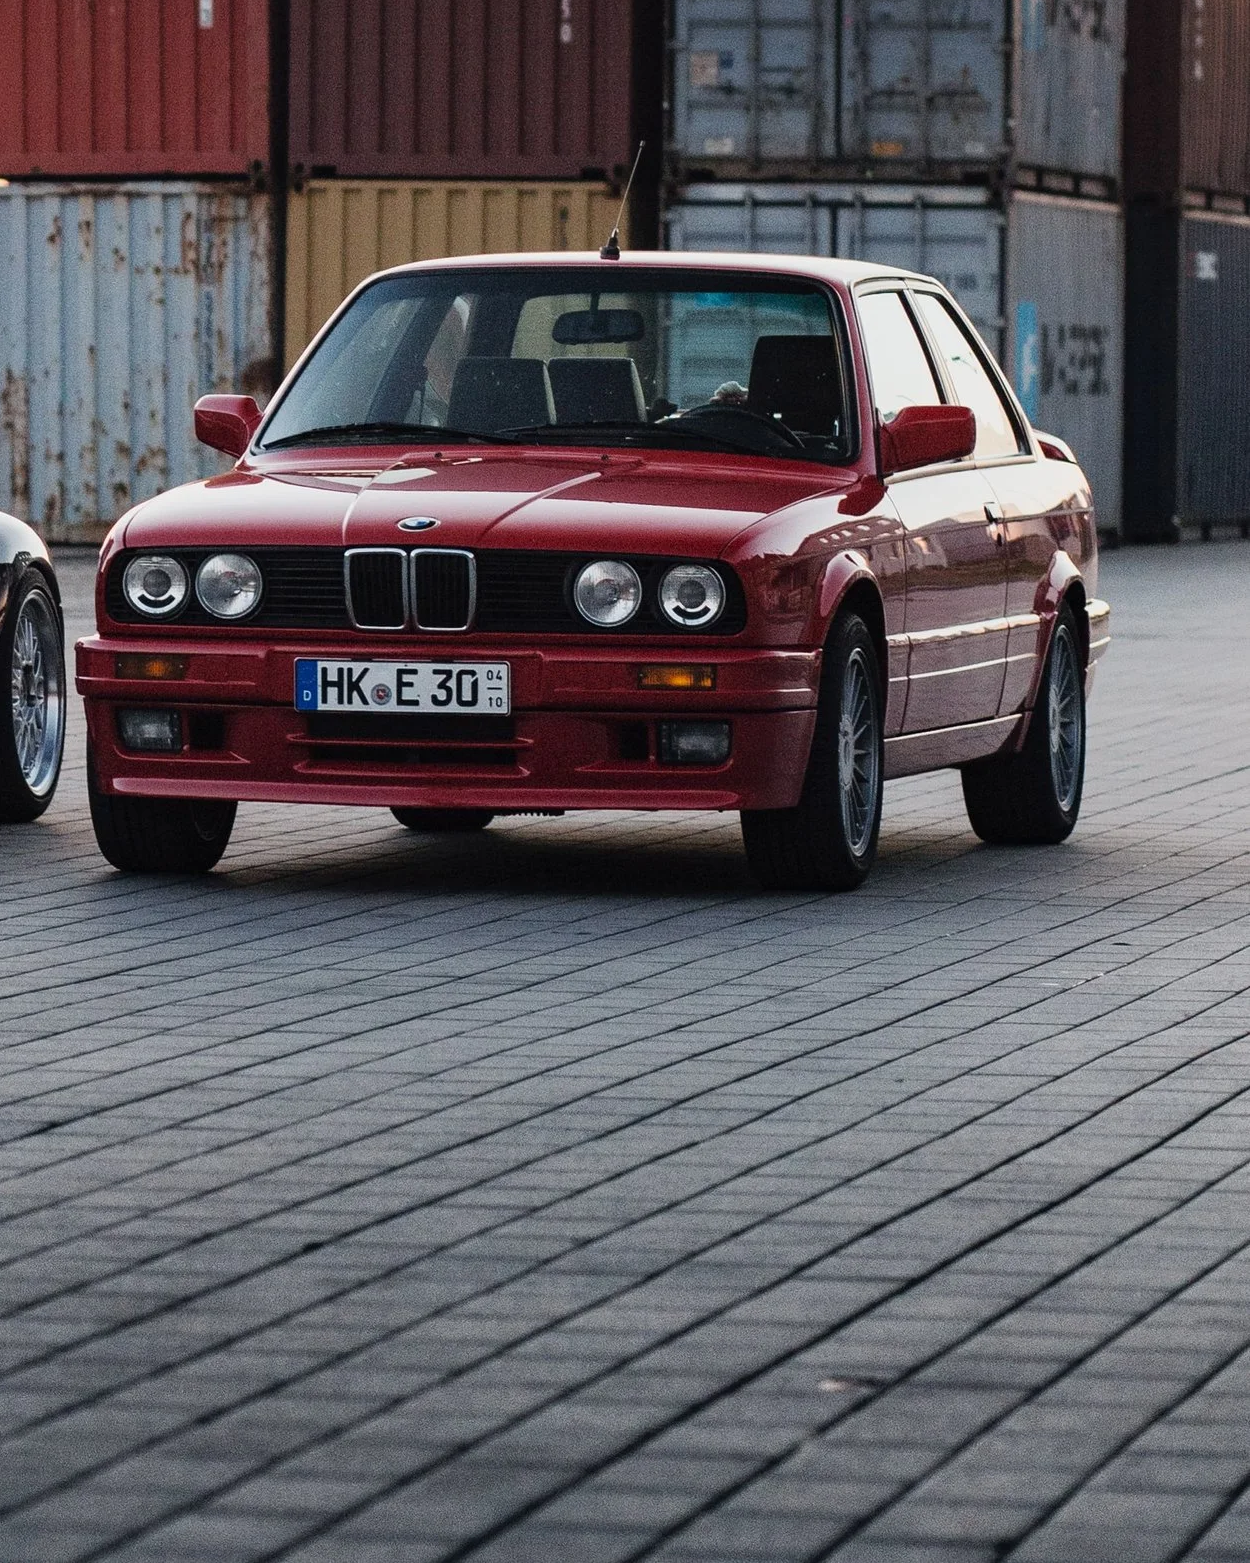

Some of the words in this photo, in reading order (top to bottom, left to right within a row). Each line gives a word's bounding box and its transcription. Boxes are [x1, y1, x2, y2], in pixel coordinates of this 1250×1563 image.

[486, 670, 503, 681] 04
[321, 666, 370, 706] HK
[396, 668, 420, 706] E
[431, 669, 479, 707] 30
[303, 690, 312, 701] D
[488, 696, 503, 708] 10
